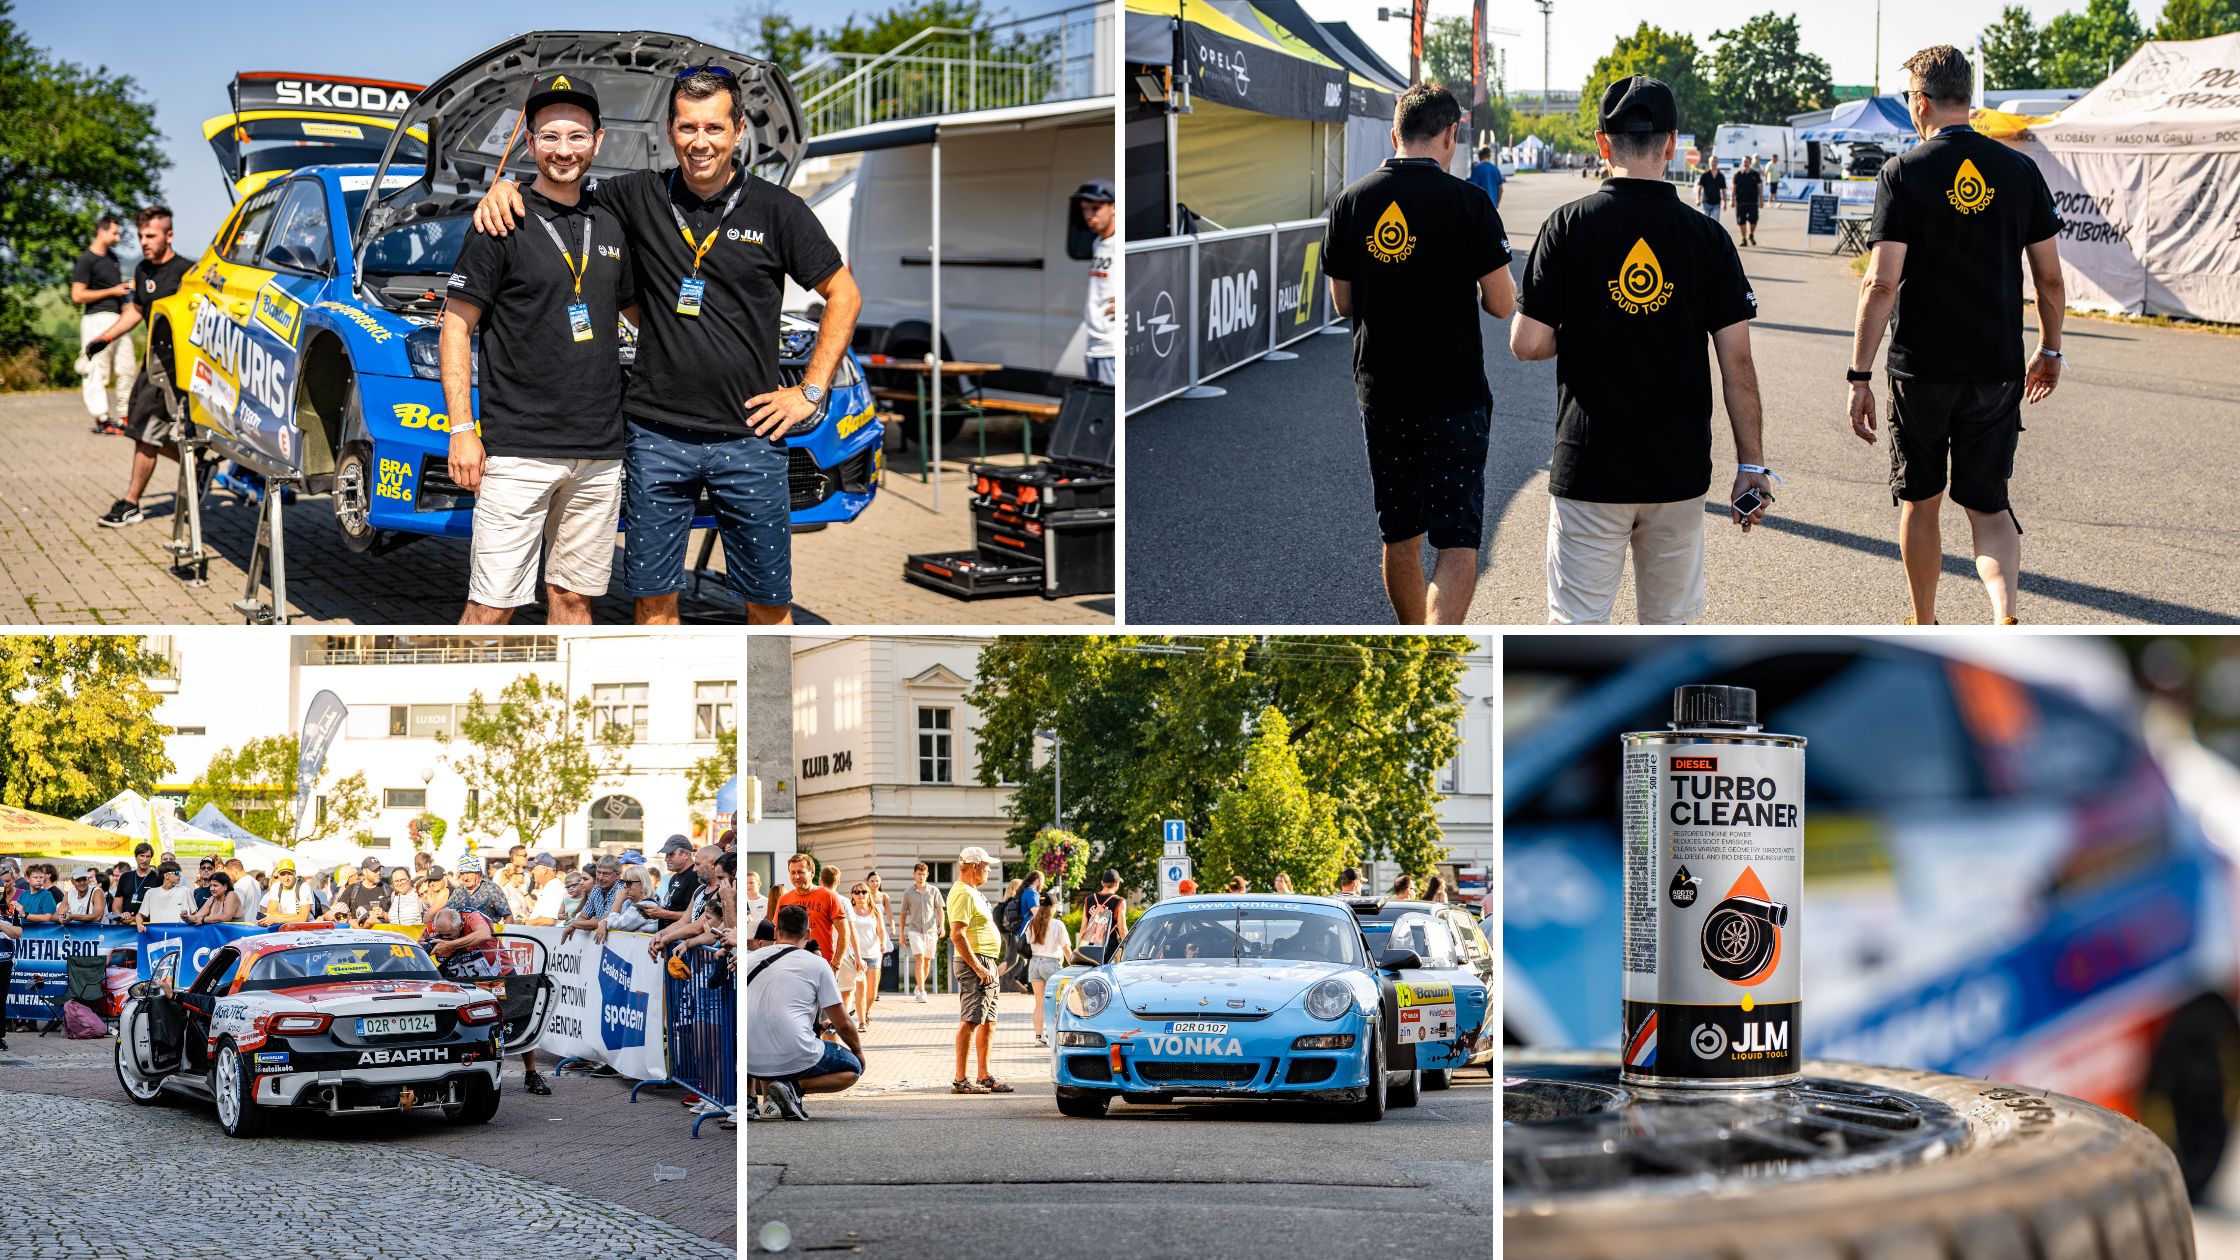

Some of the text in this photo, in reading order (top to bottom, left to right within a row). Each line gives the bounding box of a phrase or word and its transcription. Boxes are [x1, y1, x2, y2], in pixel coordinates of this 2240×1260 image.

[1200, 44, 1231, 70] OPEL
[1324, 81, 1342, 107] ADAC
[2054, 131, 2096, 143] KLOBÁSY
[2115, 135, 2143, 144] MASO
[2146, 134, 2160, 143] NA
[1946, 187, 1995, 215] LIQUID TOOLS
[2054, 189, 2114, 215] POCTIVÝ
[740, 229, 764, 242] JLM
[1366, 235, 1417, 263] LIQUID TOOLS
[1208, 268, 1258, 342] ADAC
[1278, 284, 1301, 314] RALLY
[1607, 279, 1674, 315] LIQUID TOOLS
[189, 294, 286, 419] BRAVURIS
[379, 457, 413, 477] BRA
[379, 470, 403, 487] VU
[416, 715, 447, 724] LUXOR
[802, 750, 852, 779] KLUB 204
[1650, 765, 1657, 775] ml
[1675, 759, 1713, 769] DIESEL
[1670, 775, 1777, 801] TURBO
[1670, 801, 1798, 828] CLEANER
[1705, 830, 1728, 838] ENGINE
[1188, 902, 1302, 910] www.vonka.cz
[390, 944, 416, 958] 84
[601, 953, 632, 991] Česko žije
[561, 982, 588, 1008] RTOVNÍ
[1413, 986, 1449, 999] Barum
[366, 1019, 390, 1033] 02R
[399, 1016, 430, 1031] 0124
[547, 1014, 583, 1040] GENTURA
[1175, 1023, 1196, 1032] 02R
[1198, 1023, 1227, 1032] 0107
[1731, 1020, 1788, 1052] JLM
[357, 1047, 449, 1065] ABARTH
[1148, 1037, 1244, 1057] VONKA
[1731, 1050, 1788, 1061] LIQUID TOOLS
